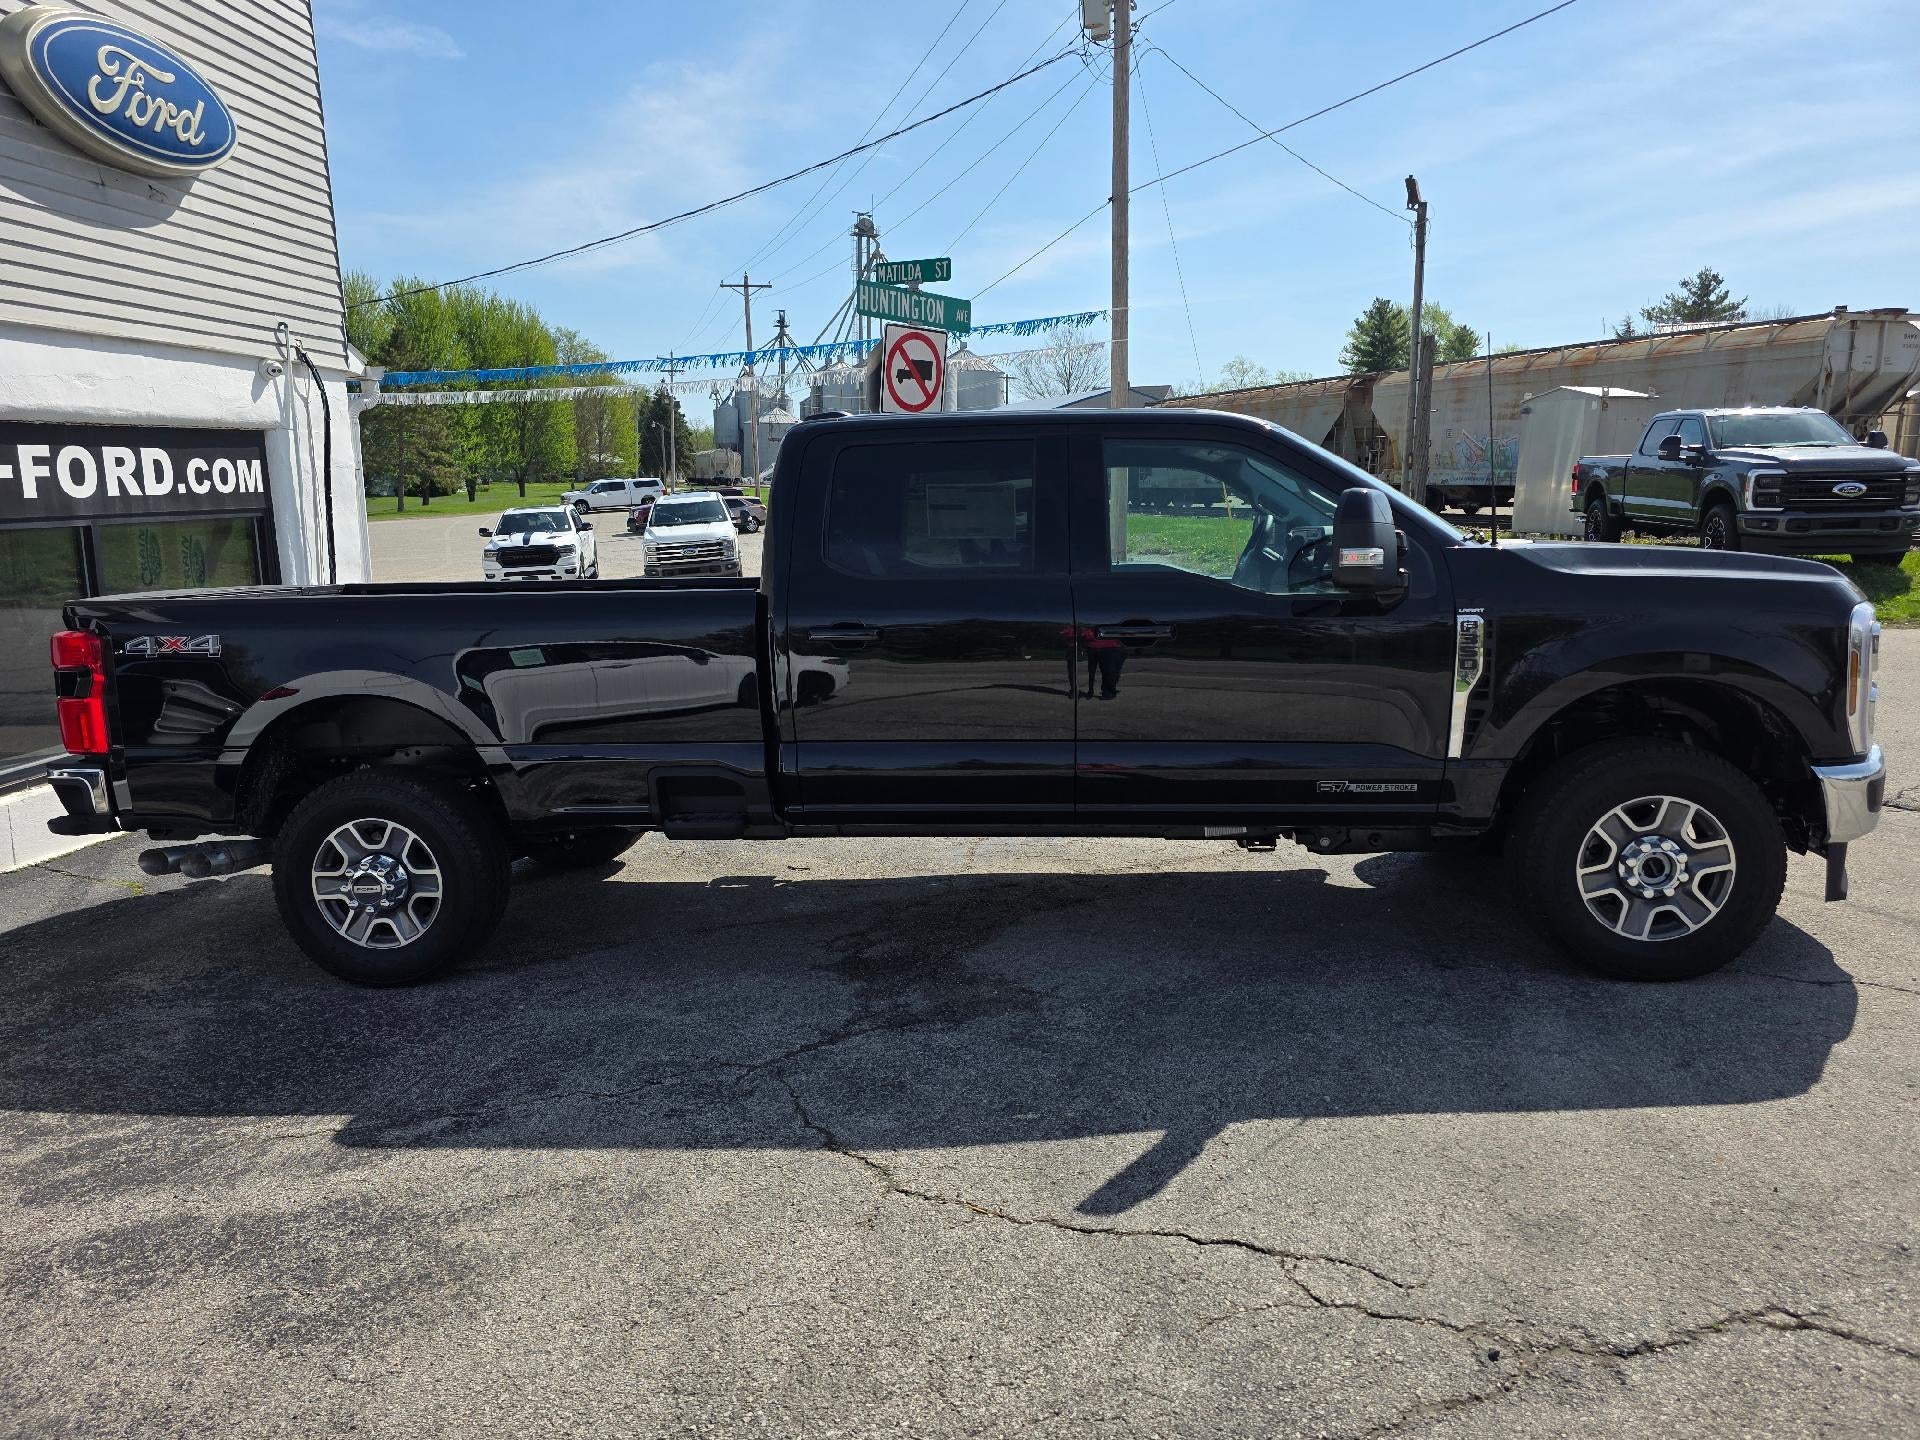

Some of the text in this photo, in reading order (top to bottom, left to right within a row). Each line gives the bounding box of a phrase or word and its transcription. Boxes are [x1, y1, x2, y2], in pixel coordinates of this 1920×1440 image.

[87, 45, 206, 146] Ford
[878, 261, 949, 283] MATILDA ST
[859, 284, 969, 325] HUNTINGTON AVE
[1355, 783, 1383, 792] POWER
[1384, 783, 1417, 792] STROKE
